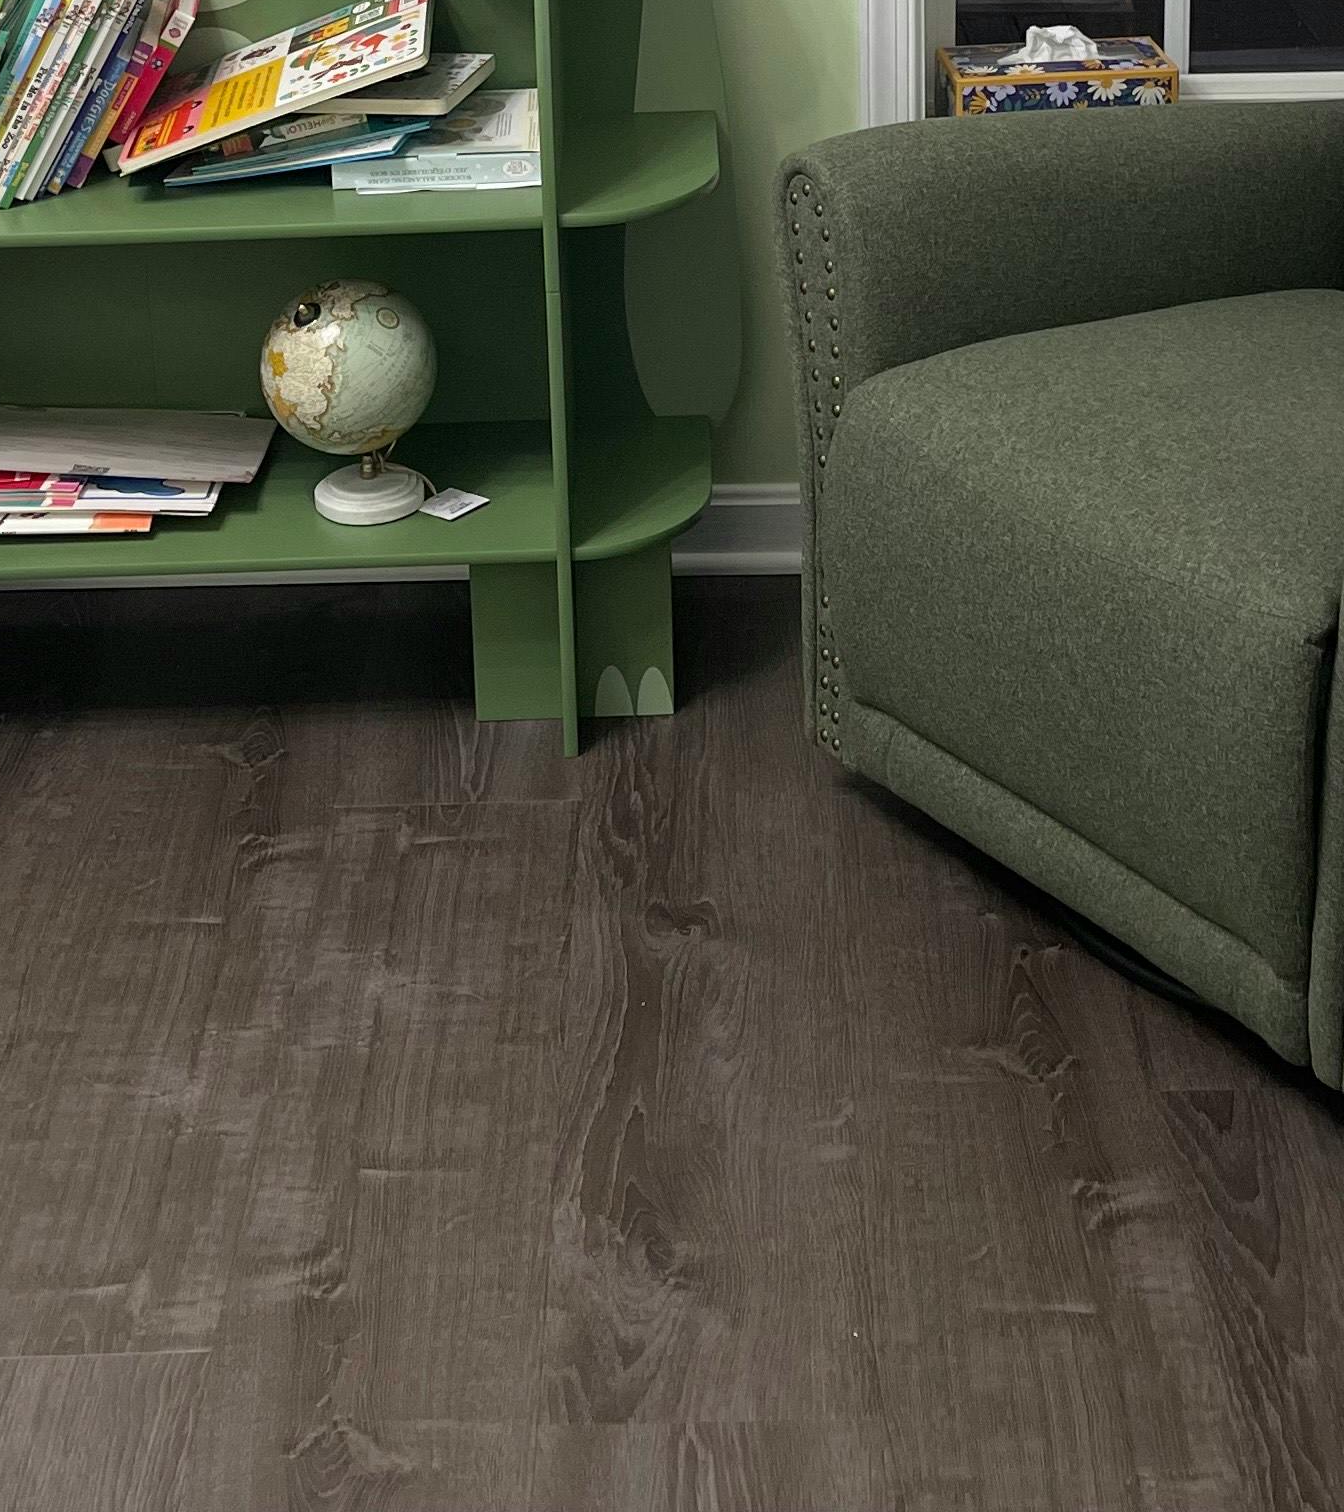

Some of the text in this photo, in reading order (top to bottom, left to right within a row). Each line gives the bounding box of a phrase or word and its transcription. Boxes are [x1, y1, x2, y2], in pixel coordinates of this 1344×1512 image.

[34, 66, 47, 84] Put
[27, 85, 37, 98] Me
[79, 78, 116, 134] DOGGIES
[12, 114, 23, 130] the
[285, 119, 321, 134] HELLO!
[1, 132, 14, 150] Zoo
[392, 175, 435, 184] BALANCING
